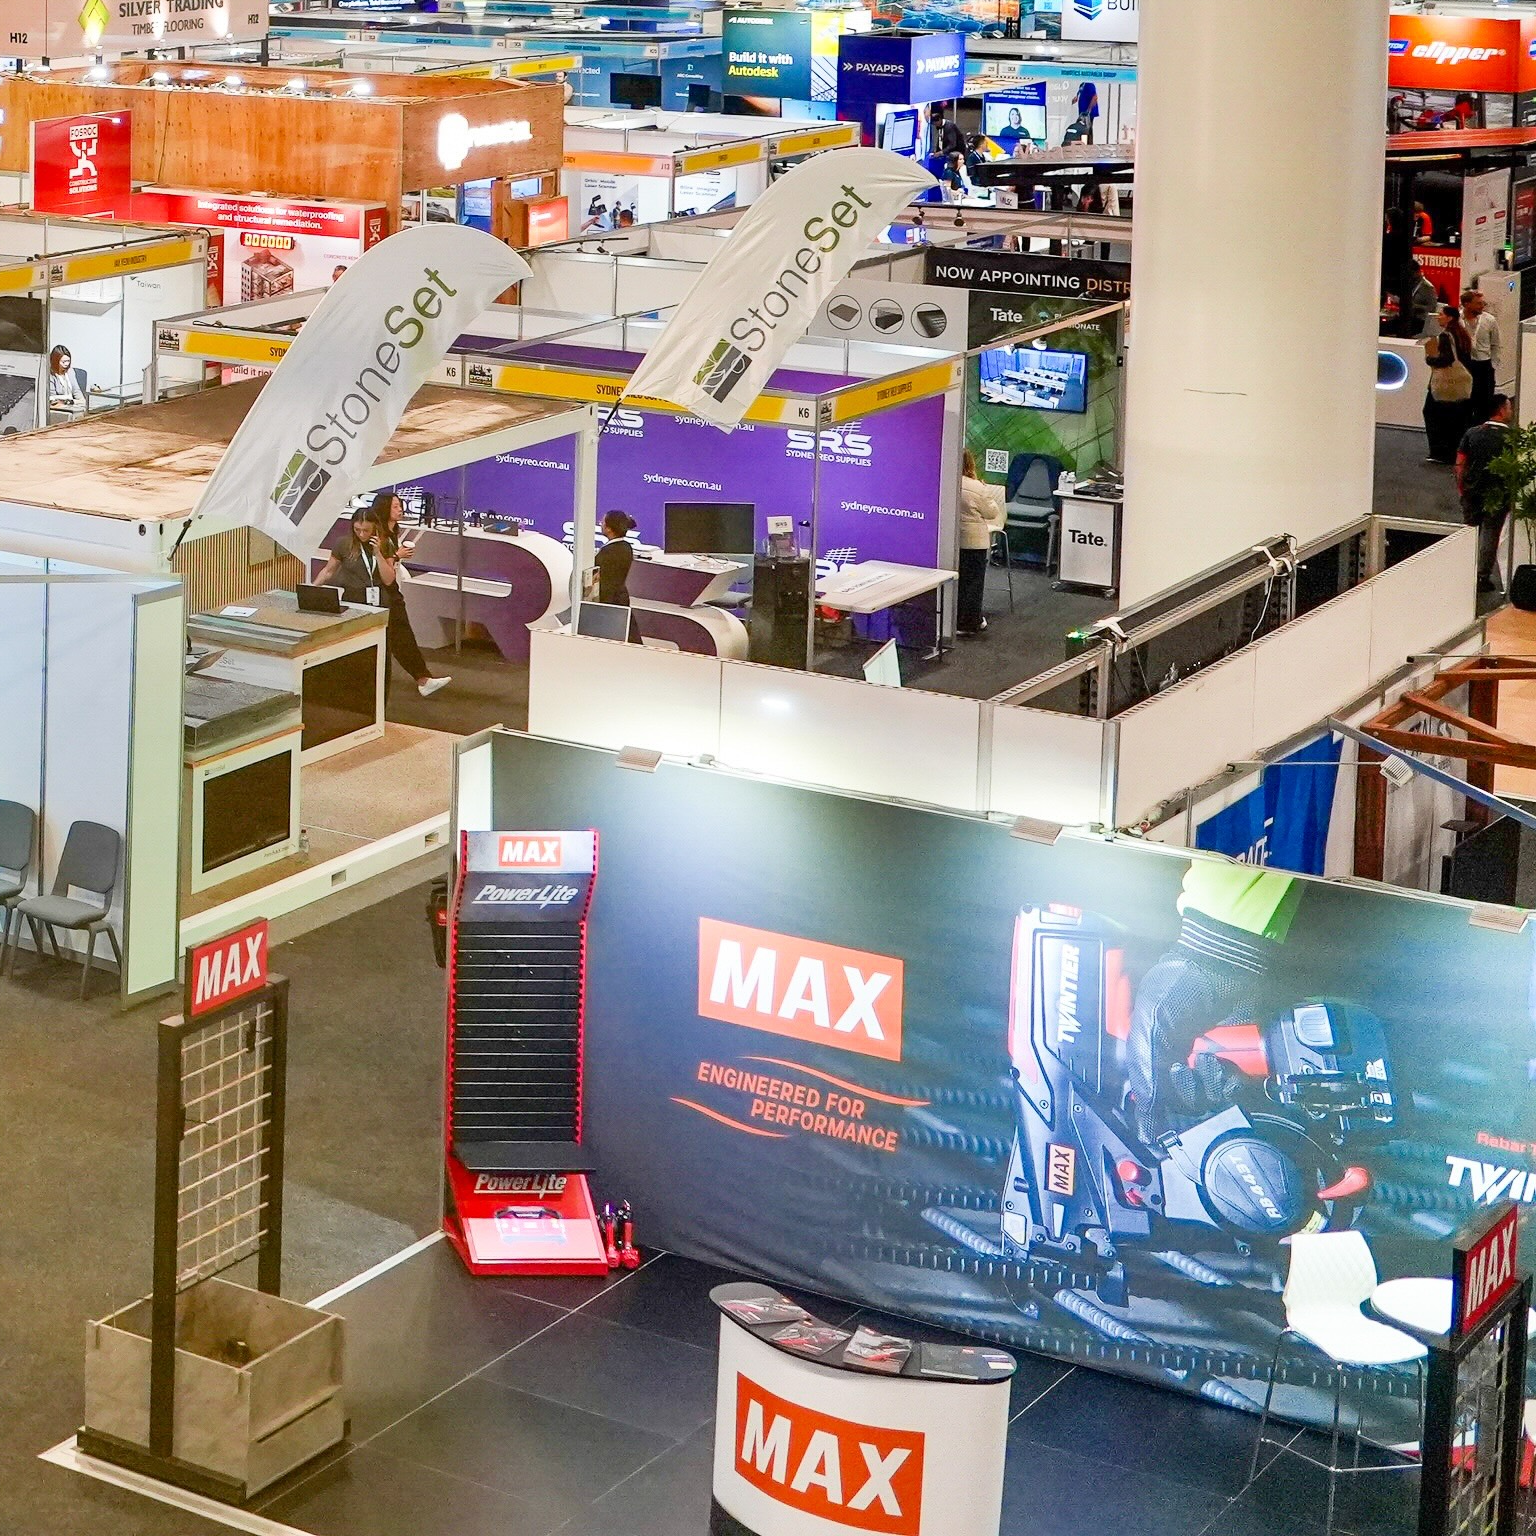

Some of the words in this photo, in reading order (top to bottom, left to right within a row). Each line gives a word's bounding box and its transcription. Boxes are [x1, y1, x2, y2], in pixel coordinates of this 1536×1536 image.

[119, 0, 161, 17] SILVER
[10, 32, 28, 44] H12
[729, 52, 756, 63] Build
[758, 52, 767, 64] it
[769, 53, 793, 65] with
[1412, 41, 1498, 64] clipper
[728, 65, 779, 78] Autodesk
[856, 63, 905, 74] PAYAPPS
[70, 126, 97, 139] FOSROC
[198, 200, 237, 212] Integrated
[239, 205, 275, 215] solutions
[288, 210, 345, 222] waterproofing
[218, 213, 232, 221] and
[234, 214, 271, 225] structural
[272, 218, 323, 229] remediation.
[730, 184, 872, 352] StoneSet
[936, 265, 975, 280] NOW
[980, 269, 1080, 289] APPOINTING
[137, 280, 162, 290] Taiwan
[990, 307, 1023, 322] Tate
[307, 267, 457, 465] StoneSet
[446, 366, 456, 378] K6
[798, 406, 810, 419] K6
[786, 429, 872, 456] SRS
[495, 452, 570, 471] sydneyreo.com.au
[818, 451, 833, 463] REO
[835, 454, 872, 467] SUPPLIES
[643, 472, 722, 492] sydneyreo.com.au
[840, 499, 924, 520] sydneyreo.com.au
[501, 839, 560, 866] MAX
[472, 882, 579, 910] PowerLite
[196, 931, 265, 998] MAX
[710, 937, 893, 1044] MAX
[1057, 945, 1081, 1044] TWINTIER
[698, 1061, 821, 1110] ENGINEERED
[824, 1091, 866, 1121] FOR
[751, 1098, 899, 1153] PERFORMANCE
[1476, 1131, 1526, 1153] Rebar
[1055, 1146, 1073, 1193] MAX
[474, 1173, 569, 1199] PowerLite
[1465, 1217, 1518, 1323] MAX
[741, 1407, 913, 1518] MAX
